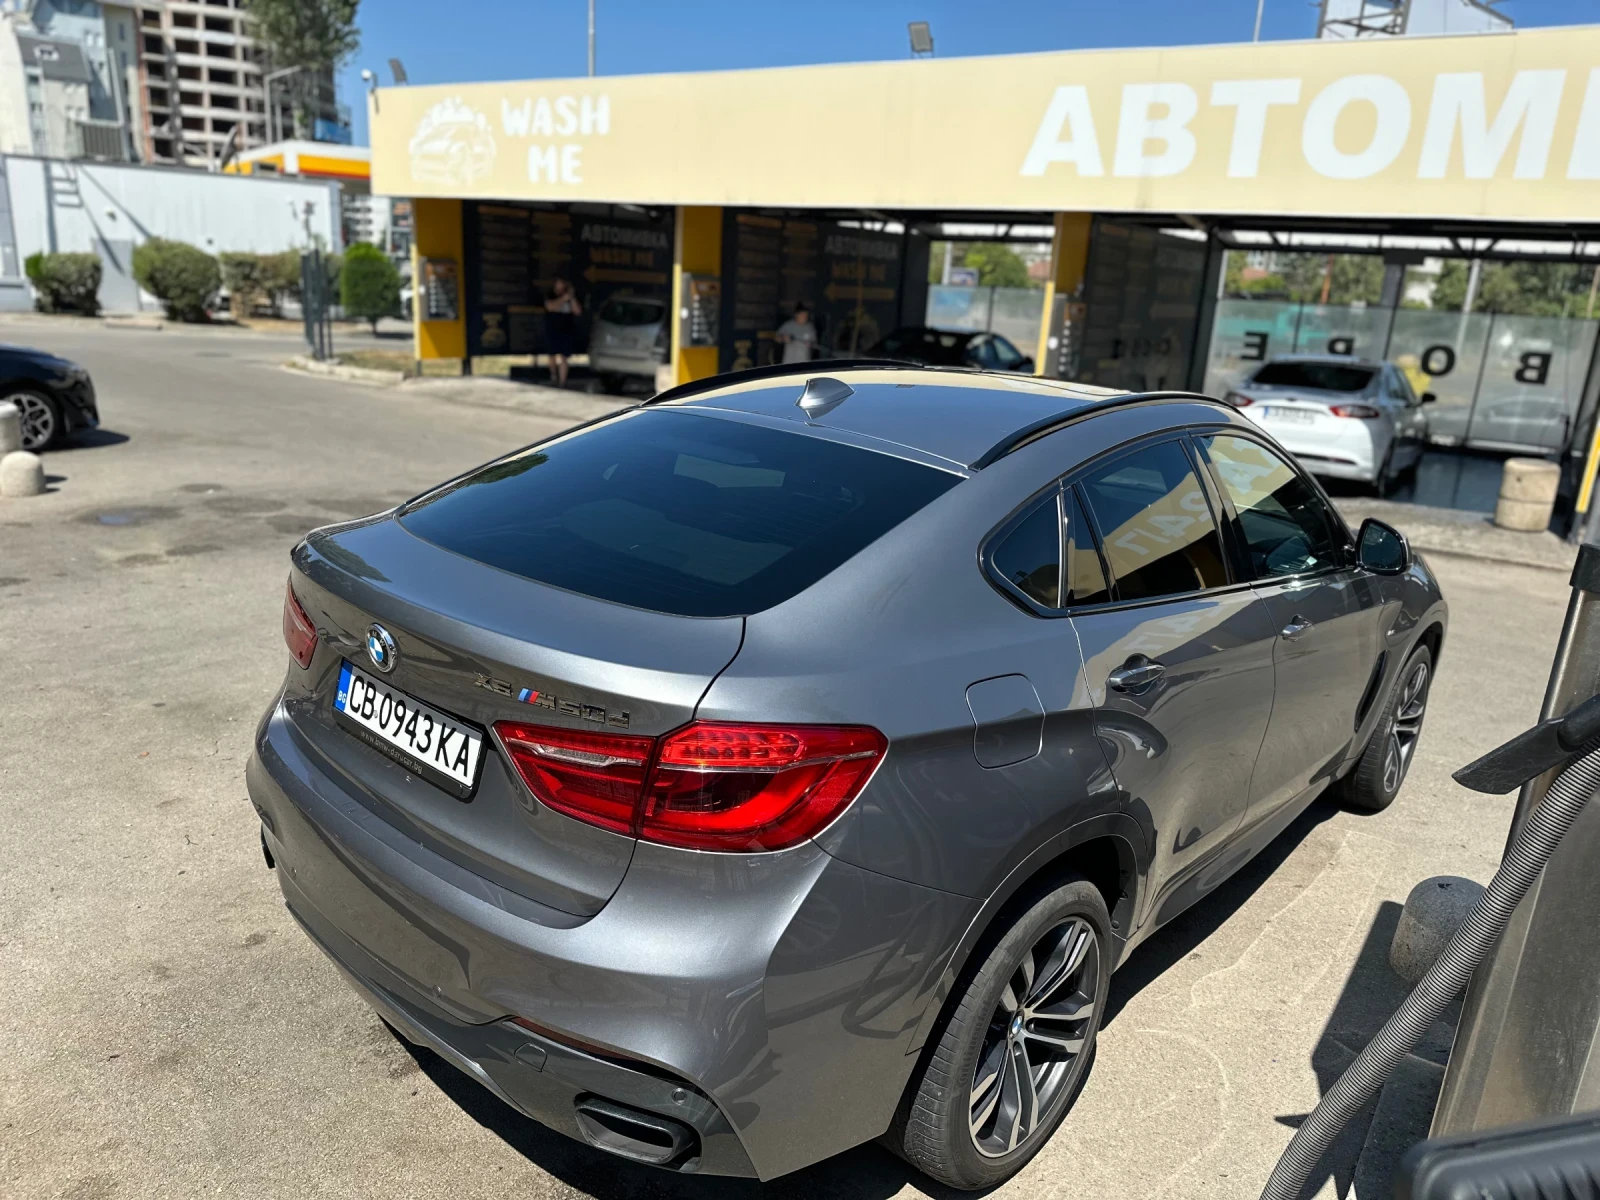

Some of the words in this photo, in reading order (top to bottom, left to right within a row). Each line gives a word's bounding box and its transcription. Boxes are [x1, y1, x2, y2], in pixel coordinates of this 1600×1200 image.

[501, 94, 611, 136] WASH
[1020, 68, 1600, 180] АВТОМ
[528, 144, 583, 184] ME
[338, 690, 347, 704] BG
